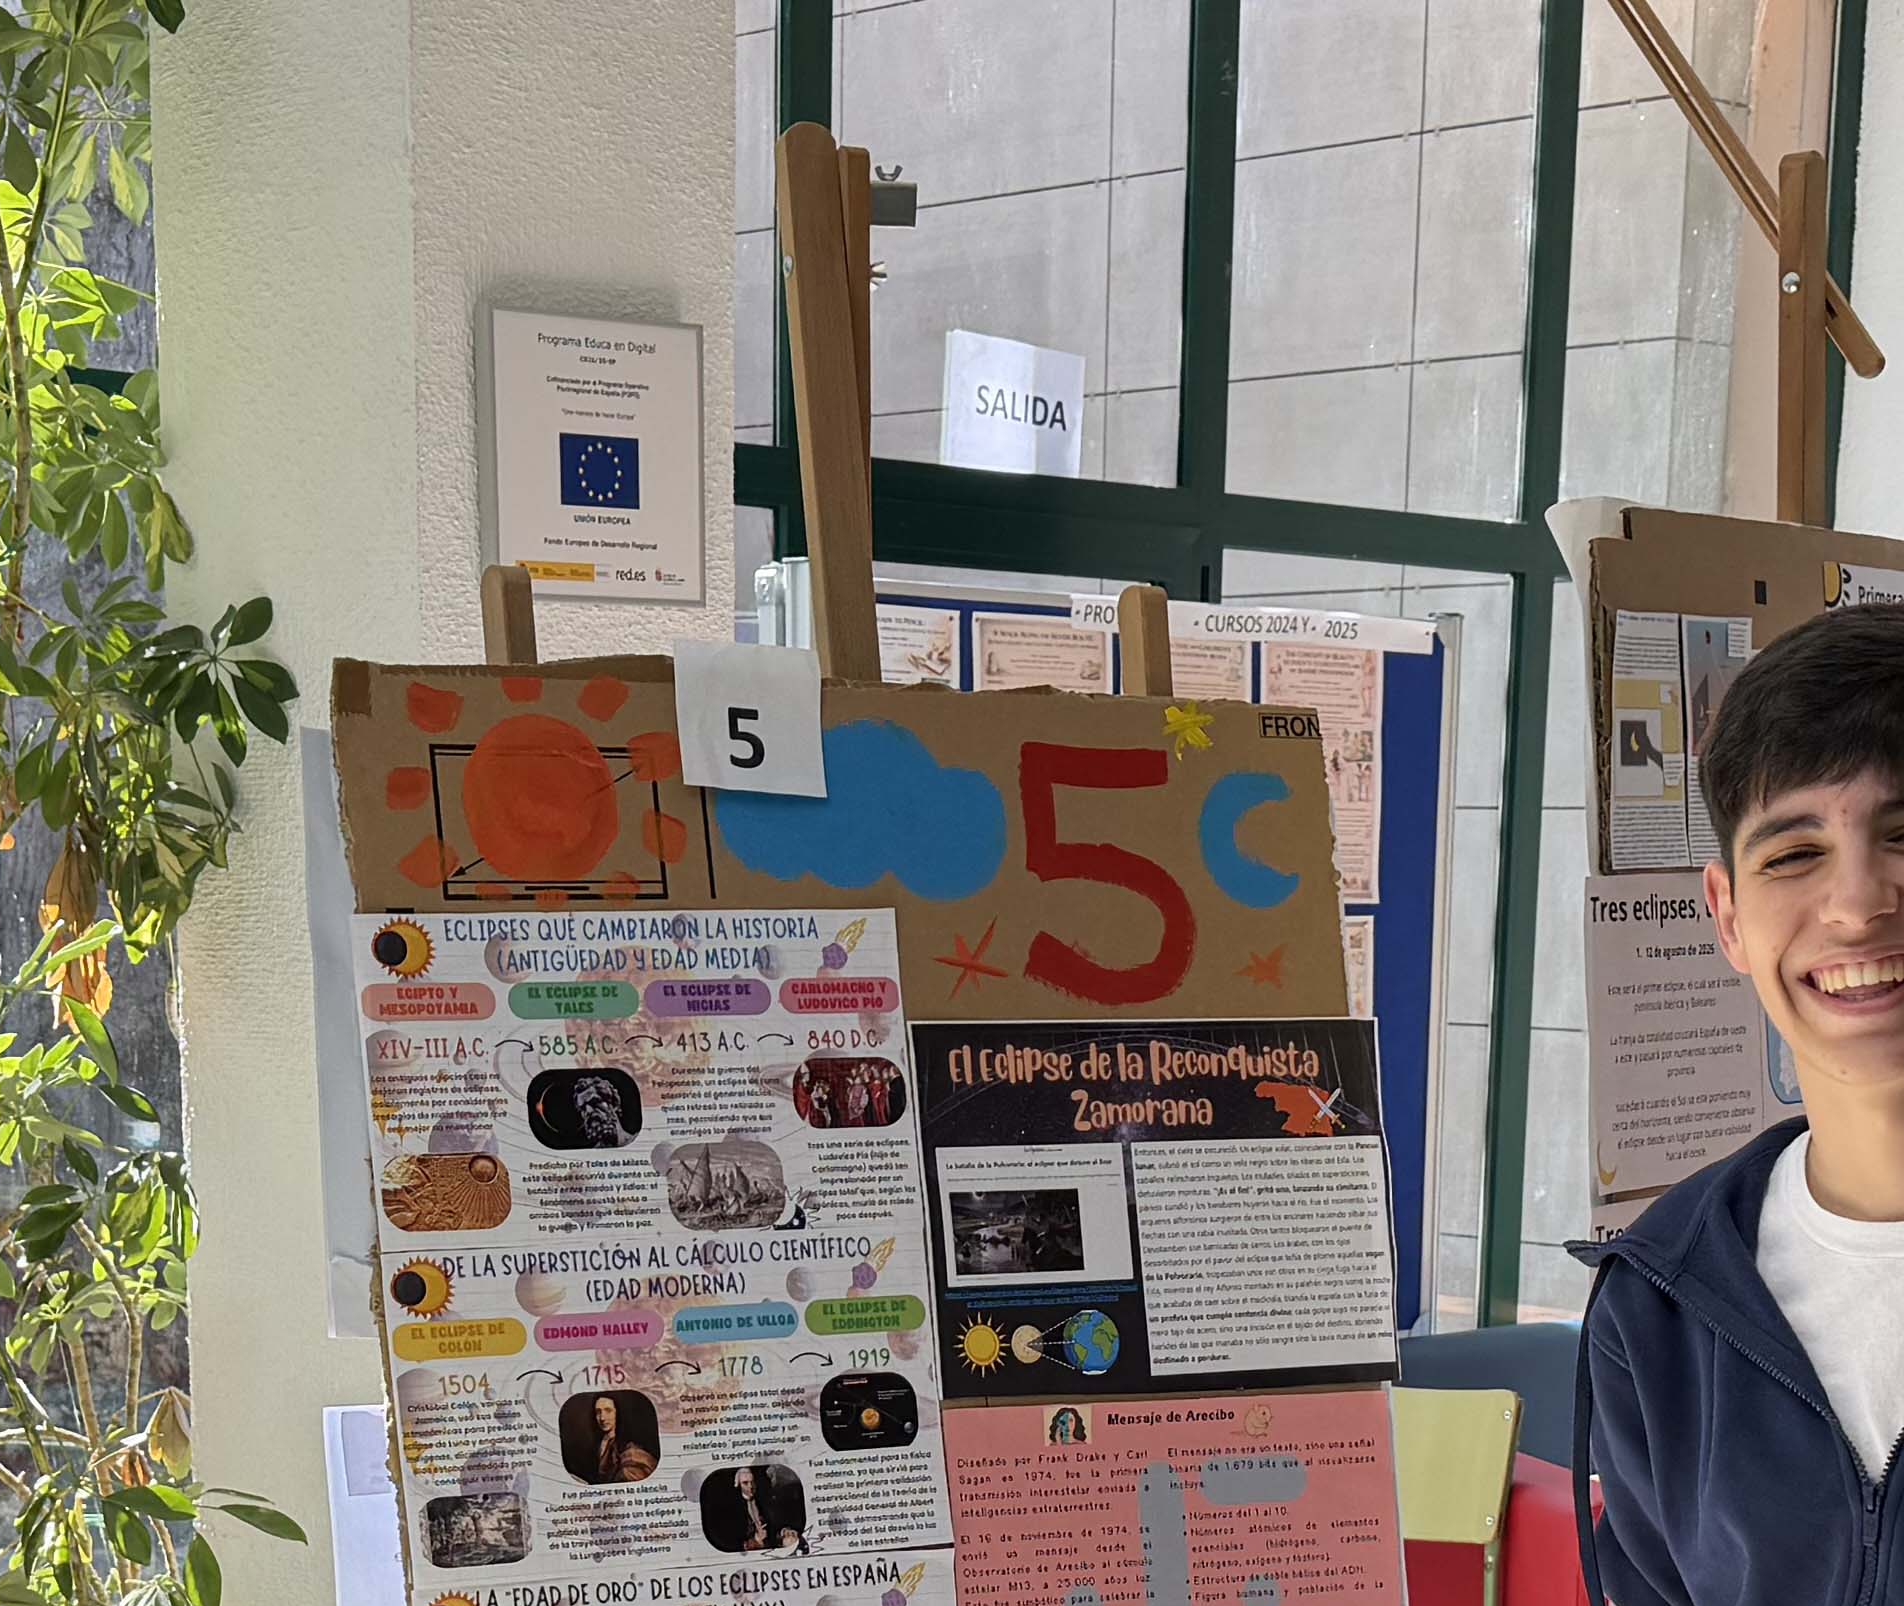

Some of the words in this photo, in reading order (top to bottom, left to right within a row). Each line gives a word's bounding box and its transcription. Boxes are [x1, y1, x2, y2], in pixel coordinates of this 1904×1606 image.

[538, 333, 581, 347] Programa
[585, 337, 611, 350] Educa
[614, 342, 625, 350] en
[628, 342, 656, 355] Digital
[975, 384, 1067, 433] SALIDA
[598, 515, 631, 525] EUROPEA
[616, 569, 646, 582] red.es
[1205, 615, 1262, 633] CURSOS
[1266, 616, 1297, 633] 2024
[1302, 617, 1310, 632] Y
[1324, 620, 1358, 640] 2025
[1262, 716, 1321, 737] FRON
[727, 706, 765, 769] 5
[1018, 741, 1195, 1006] 5
[1591, 896, 1628, 922] Tres
[1633, 893, 1700, 928] eclipses,
[444, 918, 529, 942] ECLIPSES
[583, 916, 698, 941] CAMBIARON
[706, 917, 729, 939] LA
[733, 915, 819, 938] HISTORIA
[497, 944, 626, 973] (ANTIGÜEDAD
[633, 949, 646, 971] Y
[652, 948, 697, 970] EDAD
[706, 946, 772, 969] MEDIA)
[397, 987, 443, 1000] EGIPTO
[449, 987, 458, 999] Y
[528, 988, 540, 999] EL
[545, 986, 597, 999] ECLIPSE
[602, 986, 618, 998] DE
[663, 985, 676, 996] EL
[680, 984, 731, 996] ECLIPSE
[736, 983, 751, 995] DE
[879, 982, 887, 993] Y
[379, 1002, 479, 1016] MESOPOTAMIA
[555, 1002, 593, 1015] TALES
[687, 1000, 730, 1012] NICIAS
[798, 997, 858, 1010] LUDOVICO
[377, 1037, 447, 1060] XIV-III
[454, 1036, 489, 1058] A.C.
[539, 1036, 577, 1056] 585
[585, 1035, 618, 1054] A.C.
[677, 1032, 711, 1052] 413
[718, 1031, 749, 1051] A.C.
[808, 1030, 845, 1049] 840
[851, 1029, 883, 1048] D.C.
[949, 1044, 973, 1085] El
[980, 1044, 1074, 1084] Eclipse
[1080, 1042, 1112, 1081] de
[1117, 1043, 1144, 1082] la
[1149, 1040, 1320, 1086] Reconquista
[1070, 1089, 1214, 1132] Zamorana
[443, 1256, 465, 1279] DE
[473, 1256, 496, 1278] LA
[501, 1244, 641, 1276] SUPERSTICIÓN
[648, 1247, 670, 1268] AL
[676, 1238, 763, 1267] CÁLCULO
[770, 1233, 871, 1262] CIENTÍFICO
[586, 1277, 641, 1304] (EDAD
[647, 1272, 745, 1298] MODERNA)
[839, 1302, 887, 1315] ECLIPSE
[891, 1300, 907, 1312] DE
[411, 1327, 425, 1339] EL
[430, 1323, 483, 1339] ECLIPSE
[488, 1322, 505, 1335] DE
[543, 1325, 597, 1340] EDMOND
[603, 1322, 649, 1336] HALLEY
[676, 1317, 732, 1332] ANTONIO
[737, 1315, 752, 1328] DE
[758, 1312, 795, 1327] ULLOA
[718, 1356, 763, 1377] 1778
[849, 1348, 890, 1368] 1919
[438, 1373, 490, 1396] 1504
[582, 1364, 625, 1385] 1715
[1107, 1412, 1162, 1426] Mensaje
[1166, 1410, 1182, 1422] de
[1185, 1408, 1235, 1421] Arecibo
[1015, 1457, 1030, 1466] por
[1038, 1454, 1069, 1464] Frank
[1076, 1452, 1106, 1462] Drake
[1113, 1454, 1119, 1462] y
[1127, 1450, 1148, 1460] Carl
[959, 1475, 991, 1487] Sagan
[1091, 1469, 1100, 1478] la
[1110, 1466, 1148, 1479] primera
[1030, 1486, 1090, 1497] interestelar
[960, 1506, 1028, 1519] inteligencias
[568, 1583, 589, 1606] DE
[651, 1577, 673, 1601] DE
[679, 1574, 713, 1598] LOS
[720, 1568, 800, 1595] ECLIPSES
[808, 1567, 828, 1589] EN
[833, 1557, 901, 1587] ESPAÑA
